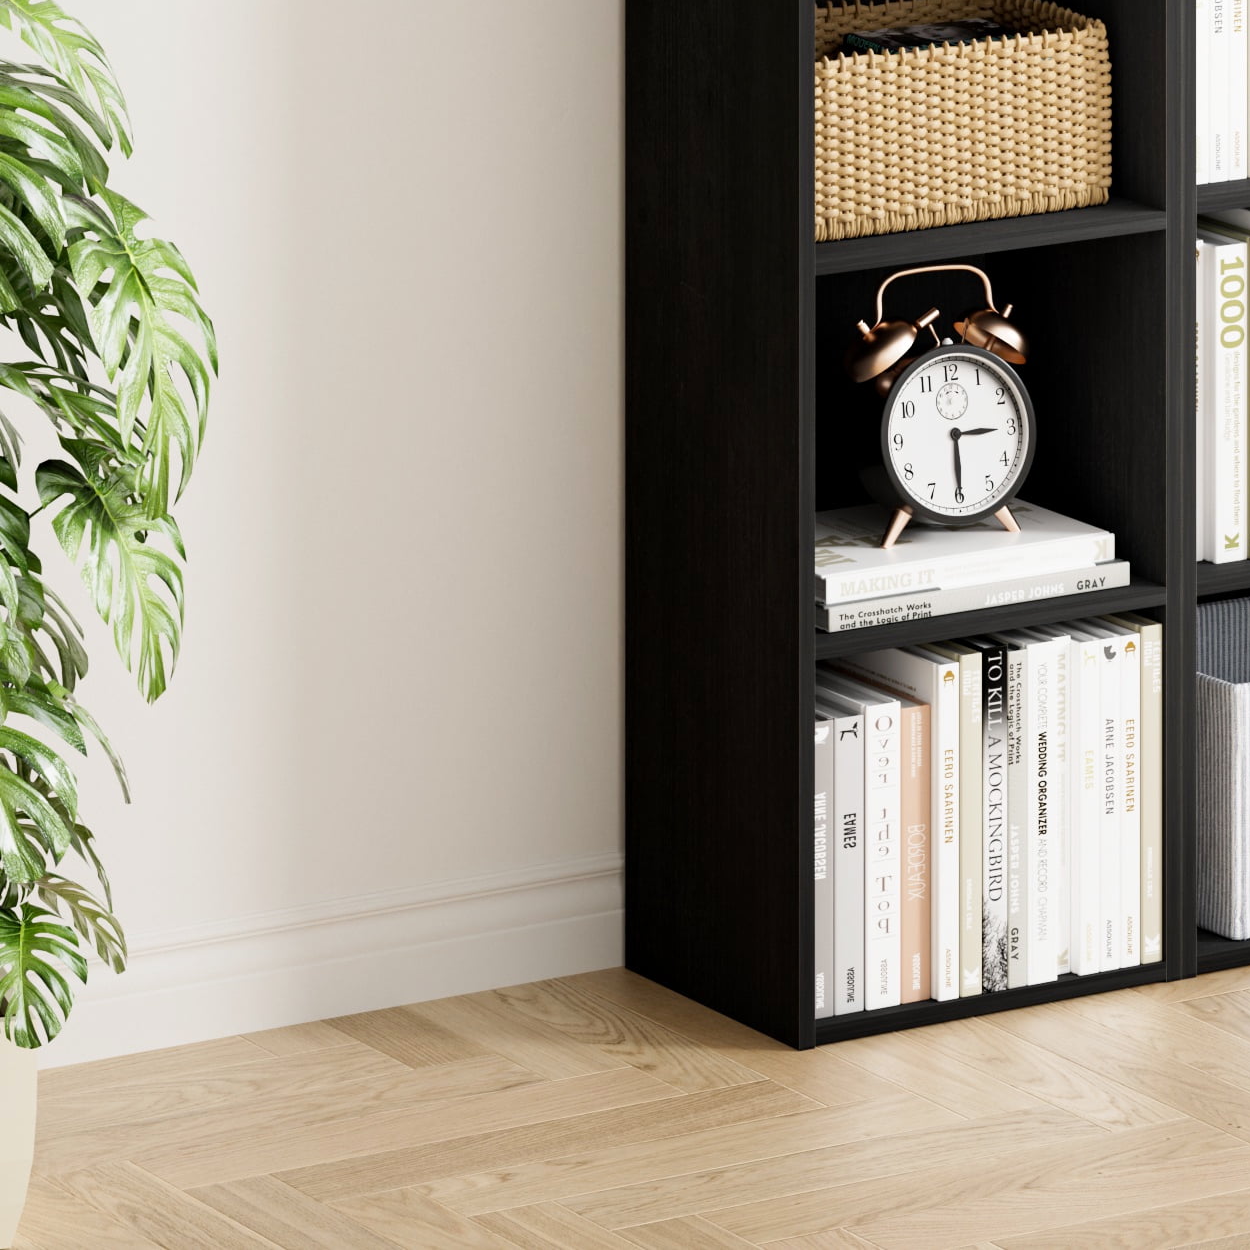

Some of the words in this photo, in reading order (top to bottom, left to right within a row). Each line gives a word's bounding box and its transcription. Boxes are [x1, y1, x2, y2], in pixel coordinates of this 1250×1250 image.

[1220, 256, 1245, 348] 1000
[919, 376, 932, 393] 11
[943, 364, 959, 382] 12
[975, 369, 981, 386] 1
[995, 388, 1006, 405] 2
[1233, 393, 1241, 405] the
[901, 401, 915, 418] 10
[1006, 419, 1016, 436] 3
[1232, 408, 1240, 438] gardens
[893, 433, 904, 451] 9
[999, 451, 1010, 467] 4
[904, 463, 914, 480] 8
[985, 475, 994, 492] 5
[927, 483, 937, 499] 7
[954, 486, 965, 503] 6
[840, 571, 912, 597] MAKING
[917, 568, 936, 585] IT
[1076, 576, 1106, 591] GRAY
[985, 590, 1025, 607] JASPER
[1028, 583, 1065, 598] JOHNS
[839, 613, 855, 622] The
[858, 605, 904, 619] Crosshatch
[906, 601, 932, 611] Works
[840, 622, 856, 630] and
[859, 619, 874, 627] the
[876, 614, 899, 627] Logic
[901, 613, 910, 621] of
[912, 609, 932, 620] Print
[988, 650, 1002, 681] TO
[988, 687, 1002, 731] KILL
[1007, 704, 1015, 728] Logic
[988, 736, 1002, 749] A
[1009, 731, 1015, 742] of
[1105, 719, 1114, 749] ARNE
[1126, 719, 1135, 749] EERO
[944, 749, 954, 778] EERO
[1038, 731, 1047, 777] WEDDING
[1085, 750, 1095, 790] EAMES
[1105, 754, 1114, 815] JACOBSEN
[1126, 754, 1135, 813] SAARINEN
[944, 783, 954, 844] SAARINEN
[1038, 780, 1047, 836] ORGANIZER
[988, 753, 1003, 902] MOCKINGBIRD
[1010, 824, 1019, 868] JASPER
[1010, 873, 1019, 914] JOHNS
[1011, 927, 1019, 960] GRAY
